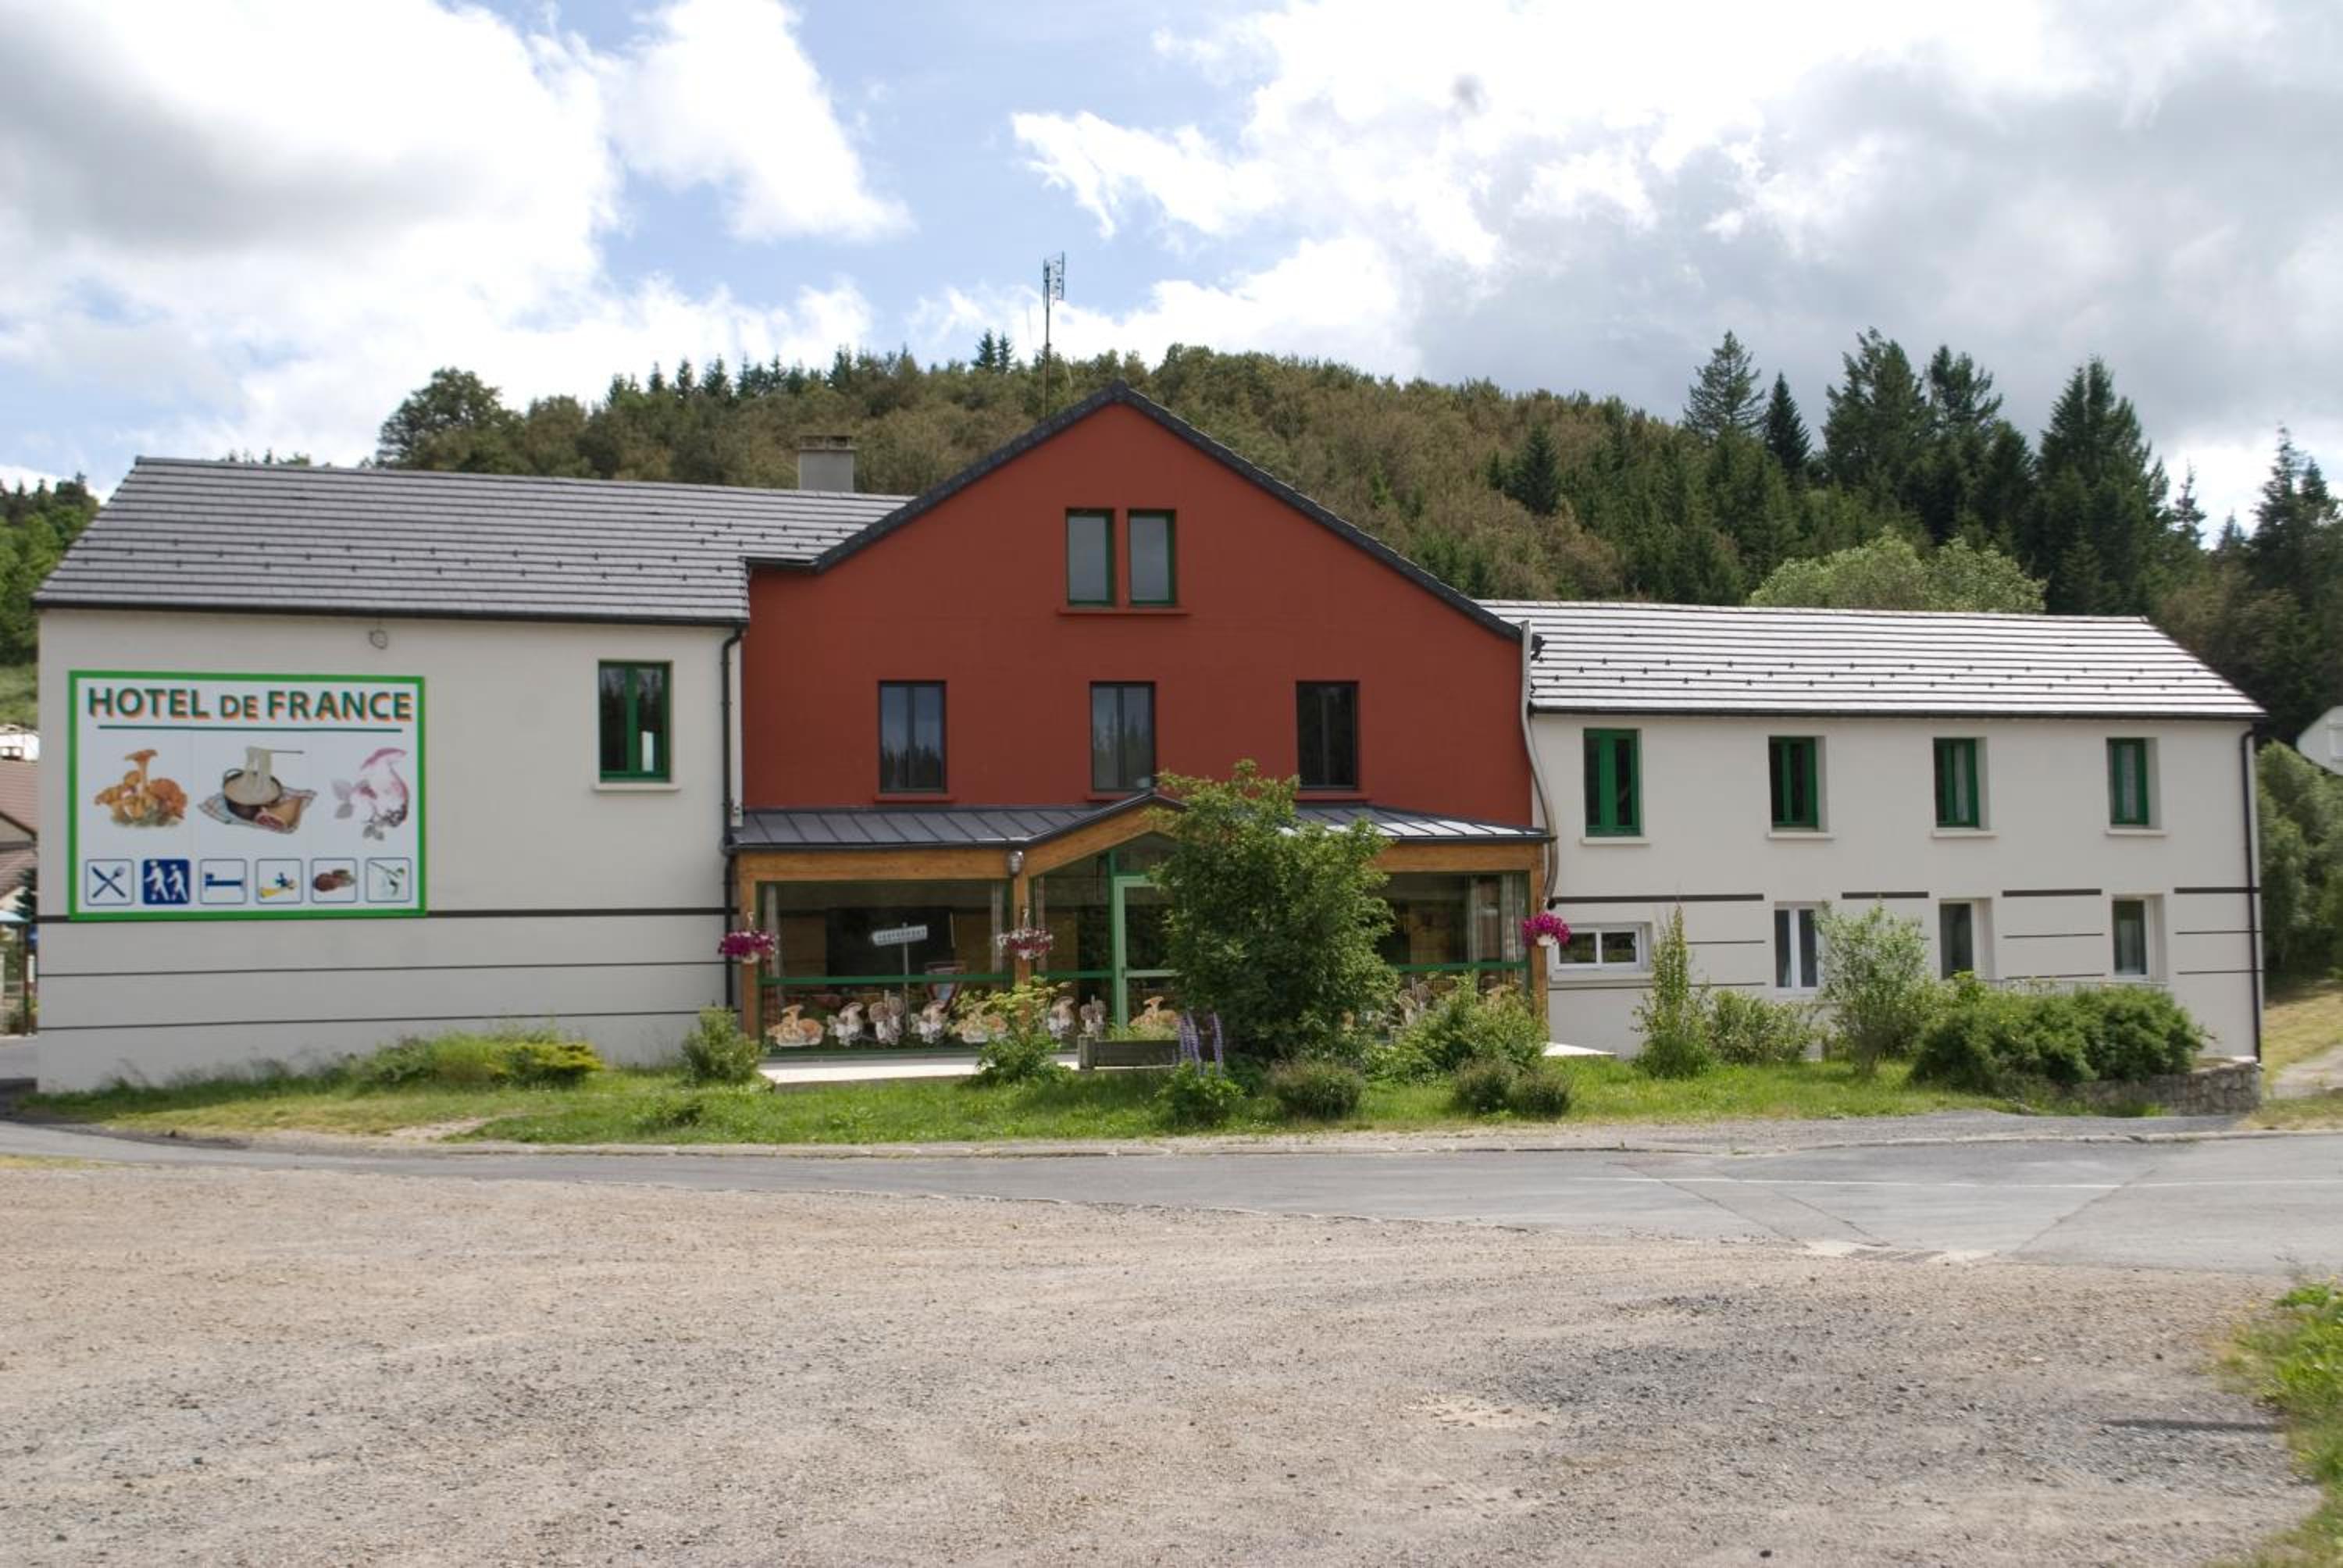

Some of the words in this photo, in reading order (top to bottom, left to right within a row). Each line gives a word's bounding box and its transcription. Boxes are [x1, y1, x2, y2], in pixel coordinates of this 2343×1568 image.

[88, 687, 210, 718] HOTEL
[219, 694, 259, 720] DE
[267, 690, 412, 722] FRANCE
